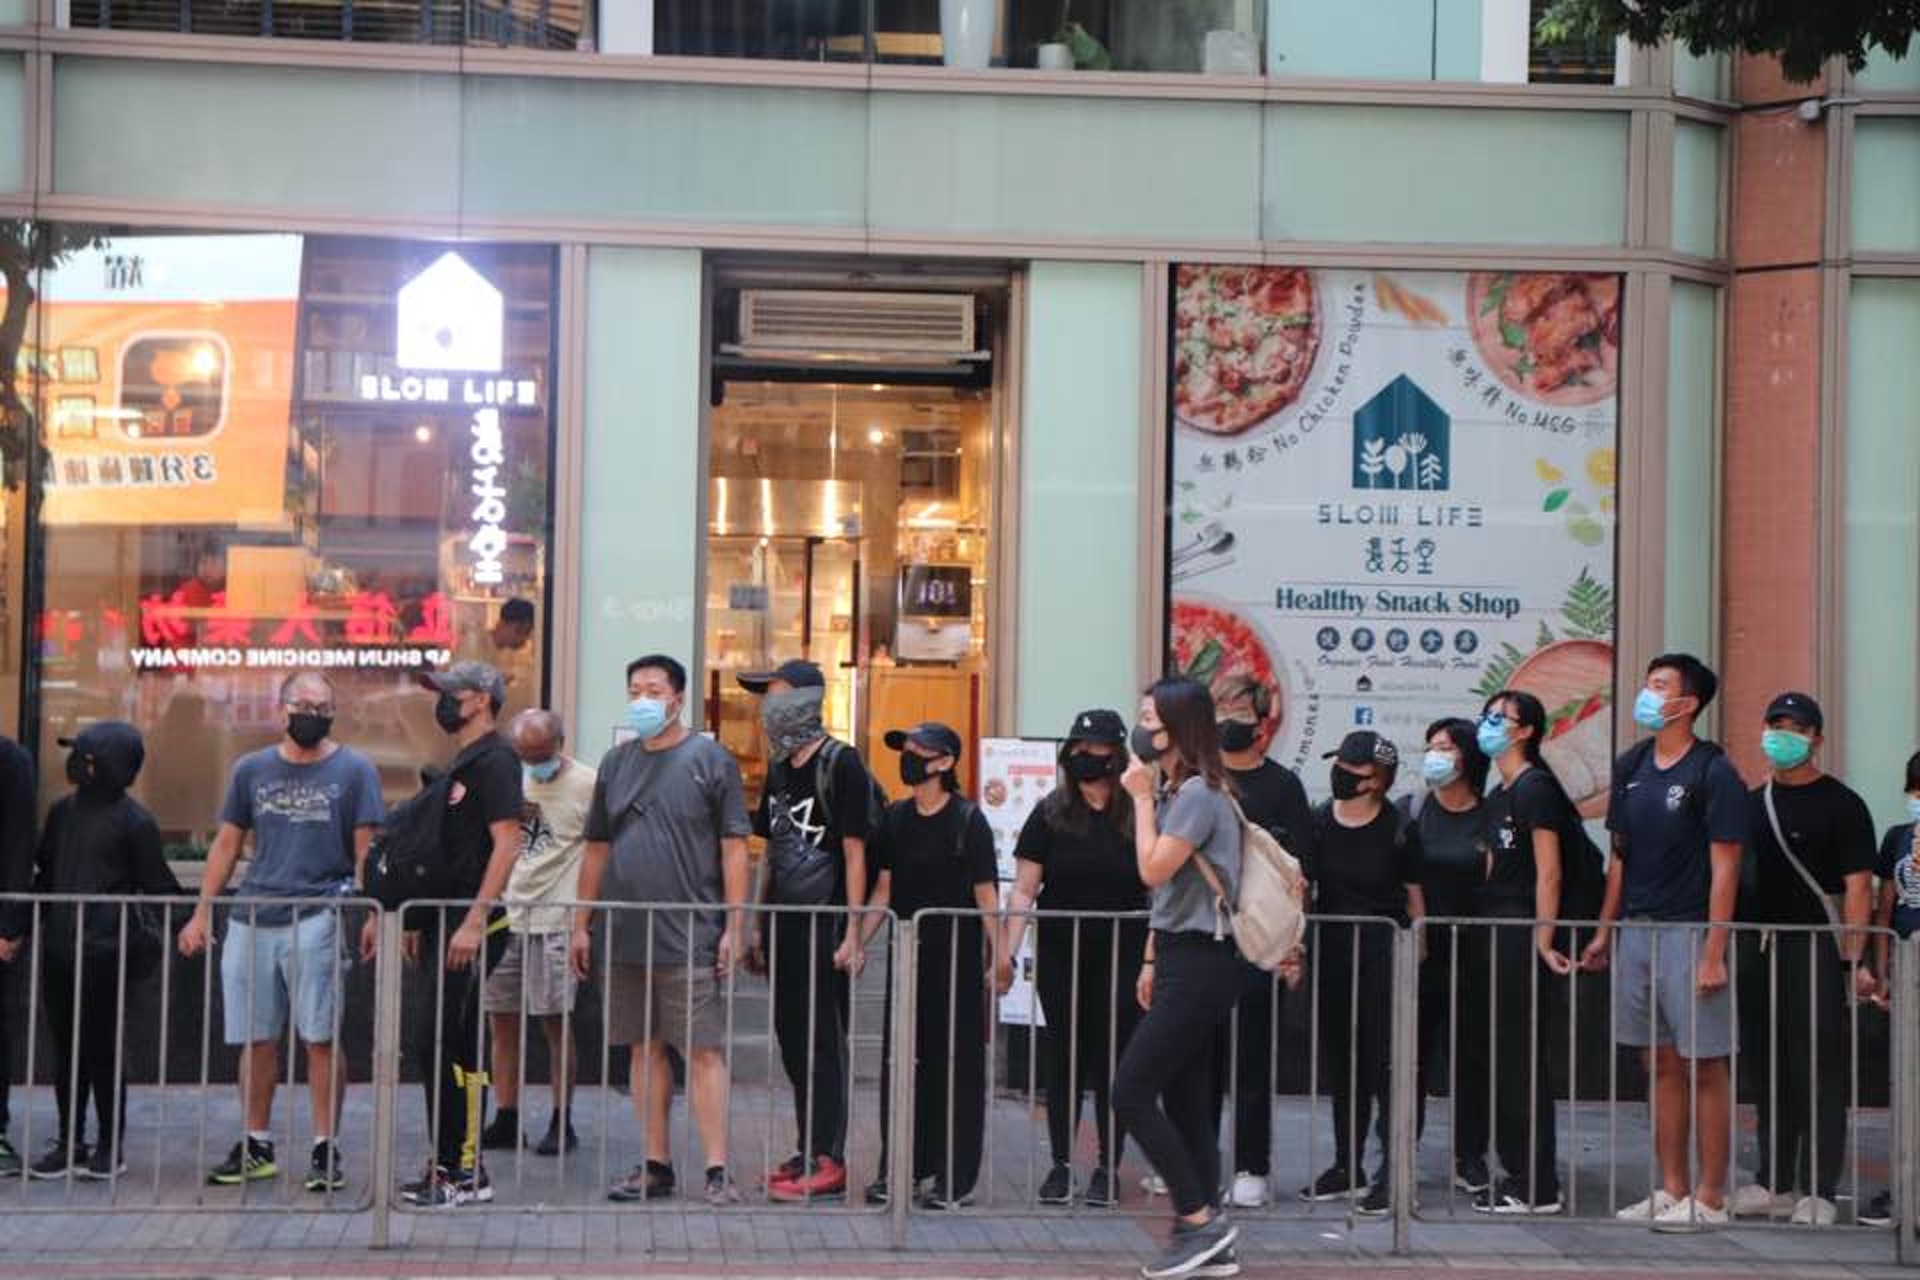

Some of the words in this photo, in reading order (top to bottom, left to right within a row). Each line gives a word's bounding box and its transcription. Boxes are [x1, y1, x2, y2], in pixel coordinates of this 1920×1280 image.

[361, 375, 449, 401] SLOW
[463, 379, 536, 405] LIFE
[1273, 431, 1299, 451] No
[1417, 506, 1483, 528] LIFE
[1275, 587, 1366, 617] Healthy
[1375, 589, 1451, 614] Snack
[1458, 591, 1521, 619] Shop
